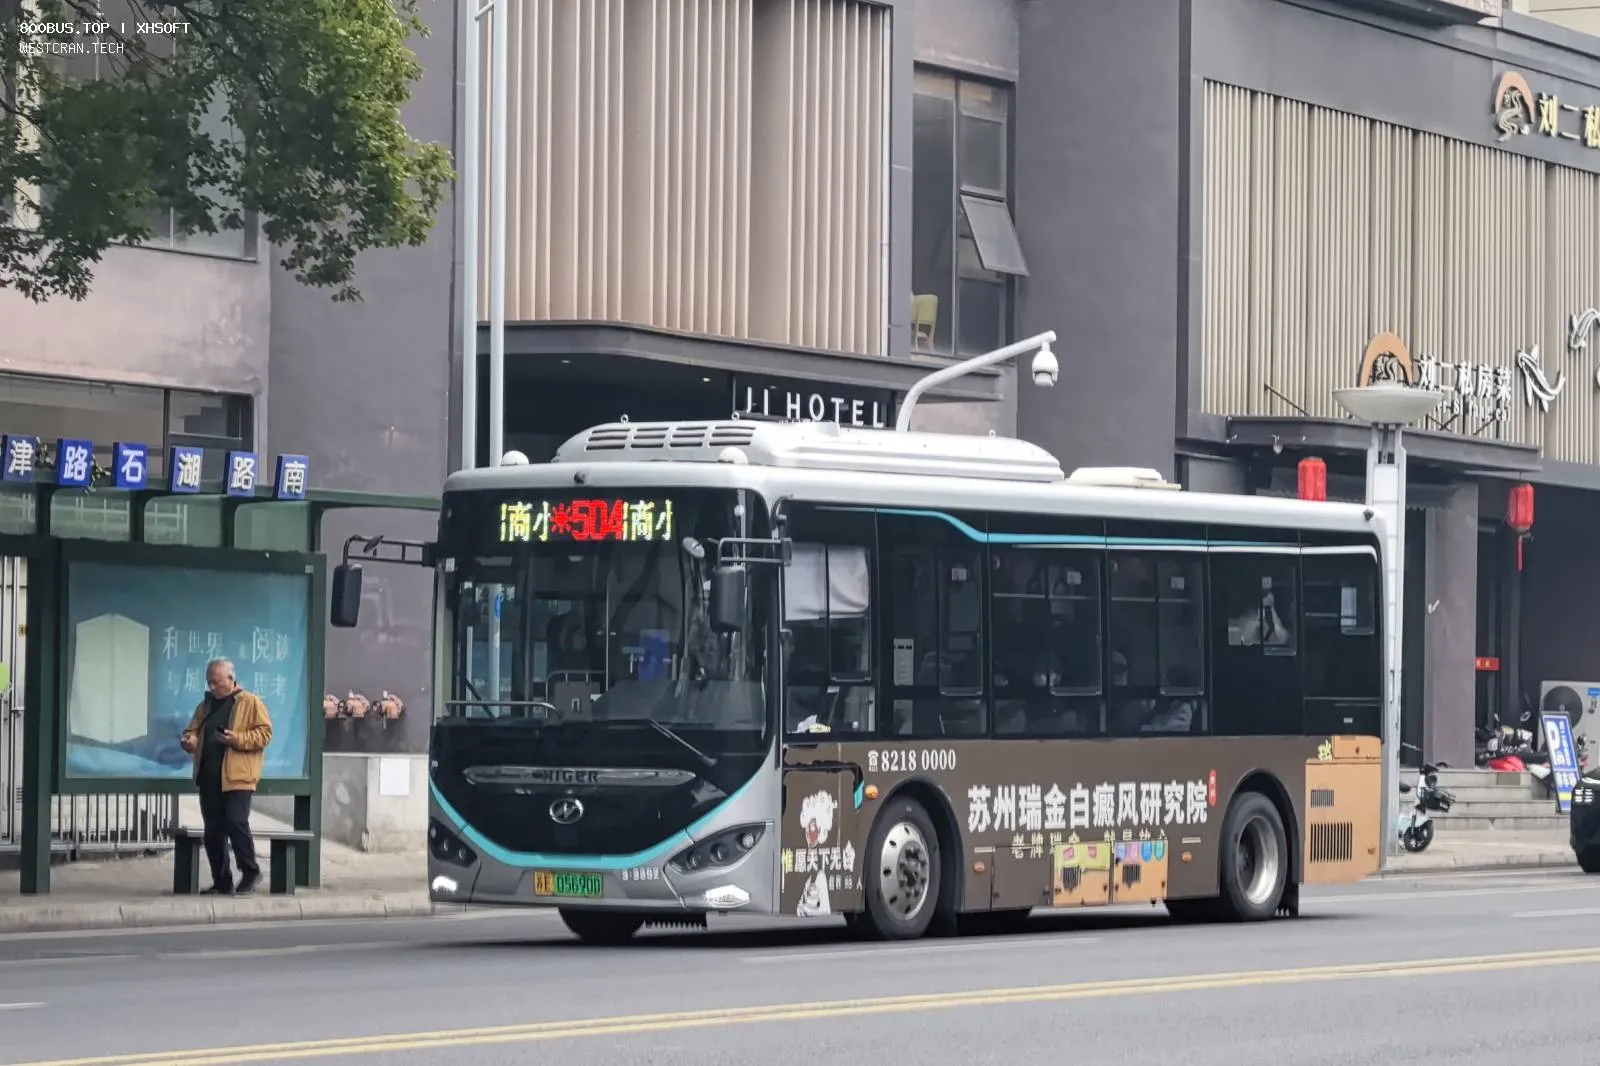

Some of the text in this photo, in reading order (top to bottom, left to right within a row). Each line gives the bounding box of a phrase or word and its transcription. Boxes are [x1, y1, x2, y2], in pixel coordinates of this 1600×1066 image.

[746, 386, 884, 428] JI HOTEL
[881, 748, 956, 772] 8218 0000
[967, 779, 1208, 833] 苏州瑞金白癜风研究院
